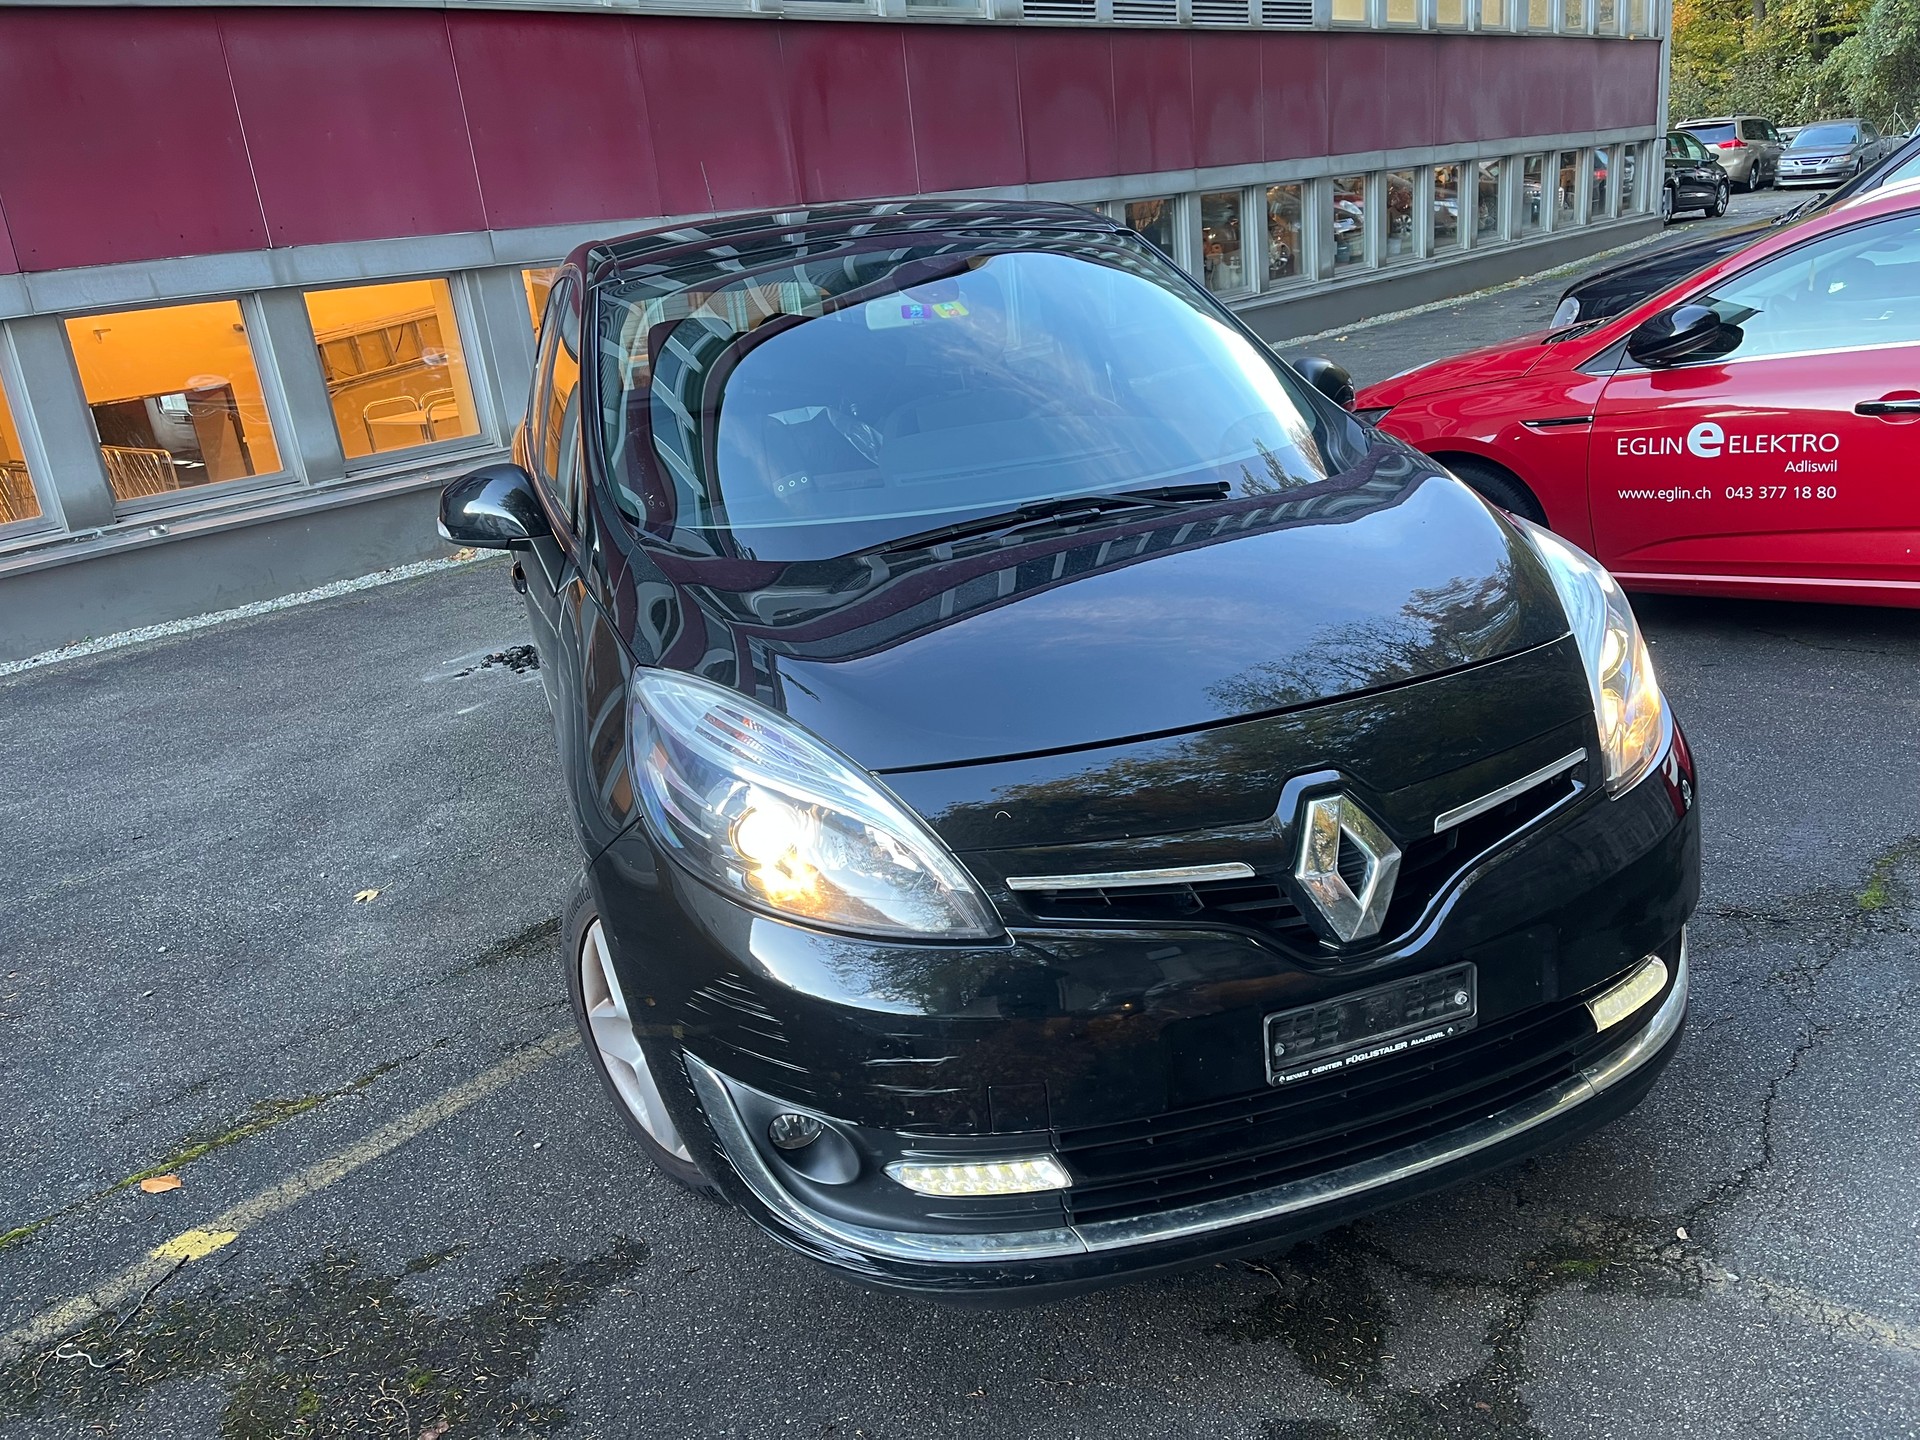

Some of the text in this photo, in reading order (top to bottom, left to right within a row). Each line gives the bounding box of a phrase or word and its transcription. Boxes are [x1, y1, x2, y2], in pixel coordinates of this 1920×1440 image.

[1617, 421, 1840, 459] EGLIN e ELEKTRO
[1784, 459, 1838, 473] Adliswil
[1617, 486, 1837, 503] www.eglin.ch 043 377 18 80
[1311, 1061, 1342, 1074] CENTER
